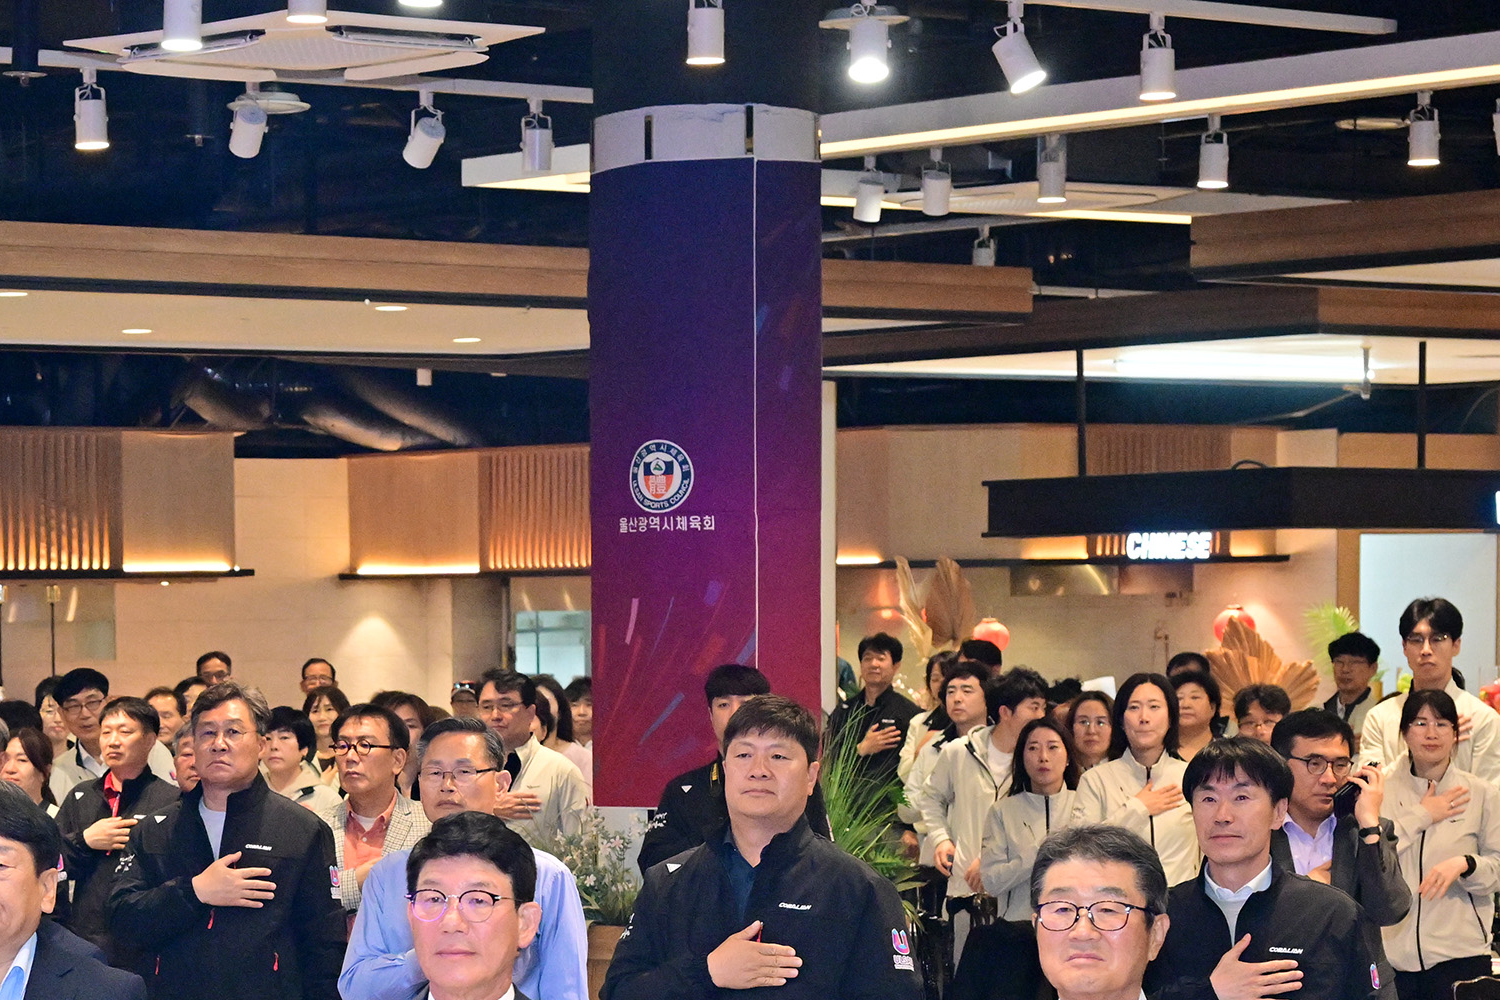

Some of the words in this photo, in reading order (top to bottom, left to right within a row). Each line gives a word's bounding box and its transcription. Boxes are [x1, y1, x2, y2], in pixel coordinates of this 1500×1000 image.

[643, 500, 669, 509] SPORTS
[670, 478, 690, 505] COUNCIL
[619, 515, 715, 533] 울산광역시체육회
[1126, 532, 1213, 560] CHINESE
